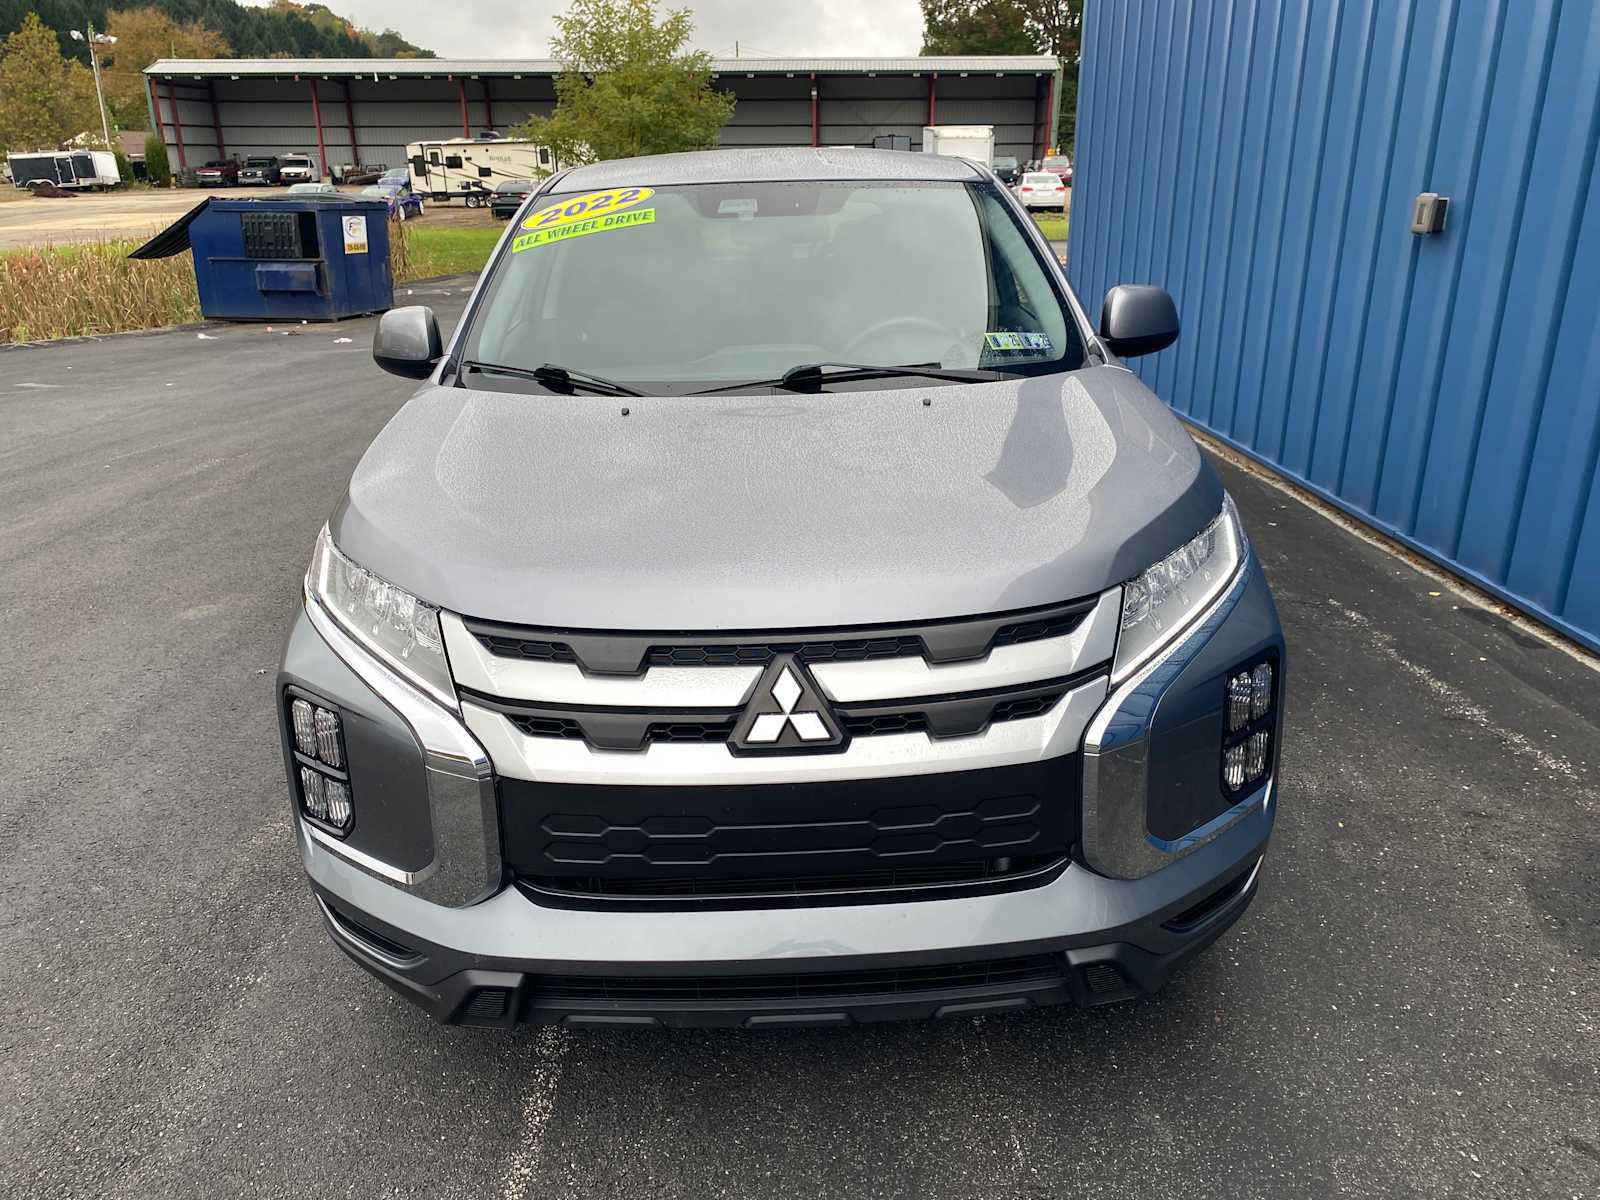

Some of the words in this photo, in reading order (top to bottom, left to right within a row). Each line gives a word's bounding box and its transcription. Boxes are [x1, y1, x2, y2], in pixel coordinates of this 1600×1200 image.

[537, 188, 641, 225] 2022
[515, 234, 542, 249] ALL
[548, 220, 600, 239] WHEEL
[604, 210, 652, 227] DRIVE
